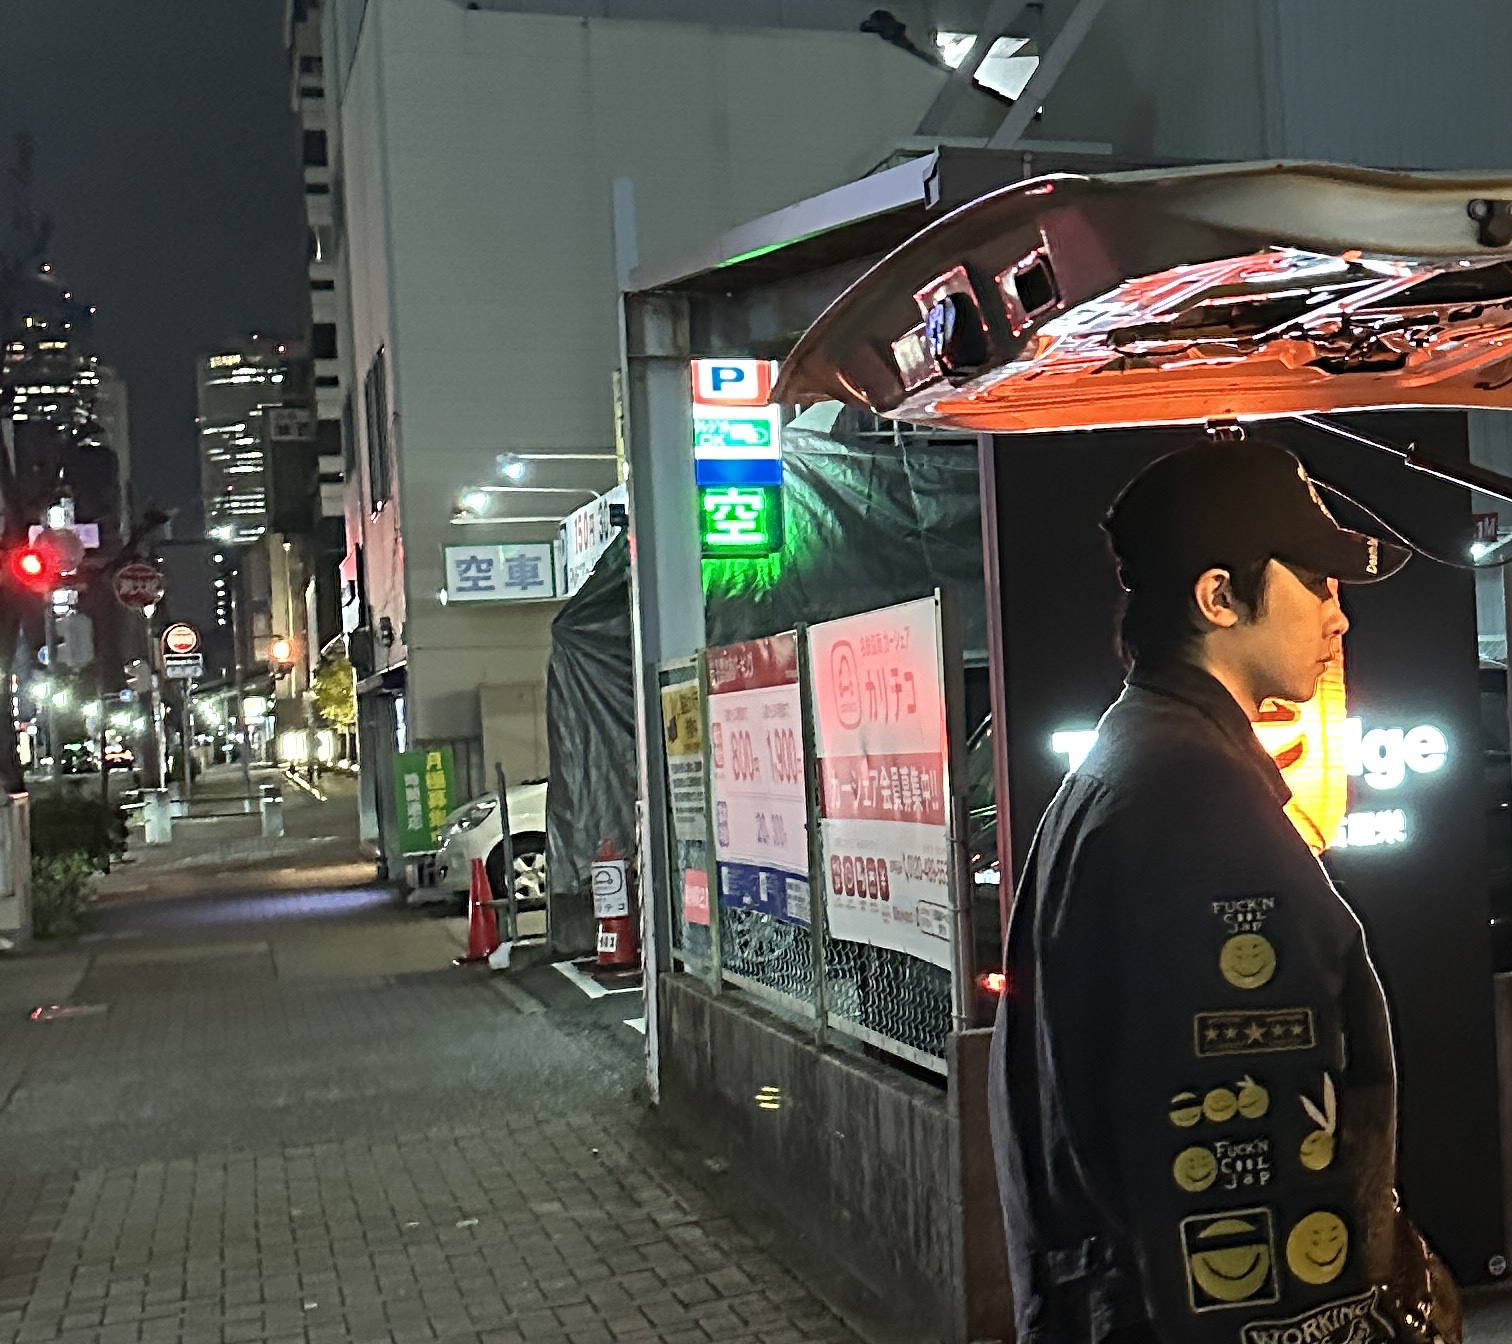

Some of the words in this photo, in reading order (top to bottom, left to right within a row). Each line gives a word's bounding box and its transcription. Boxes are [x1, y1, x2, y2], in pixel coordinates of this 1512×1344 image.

[711, 366, 745, 392] P
[703, 487, 768, 545] 空
[454, 554, 545, 593] 空車
